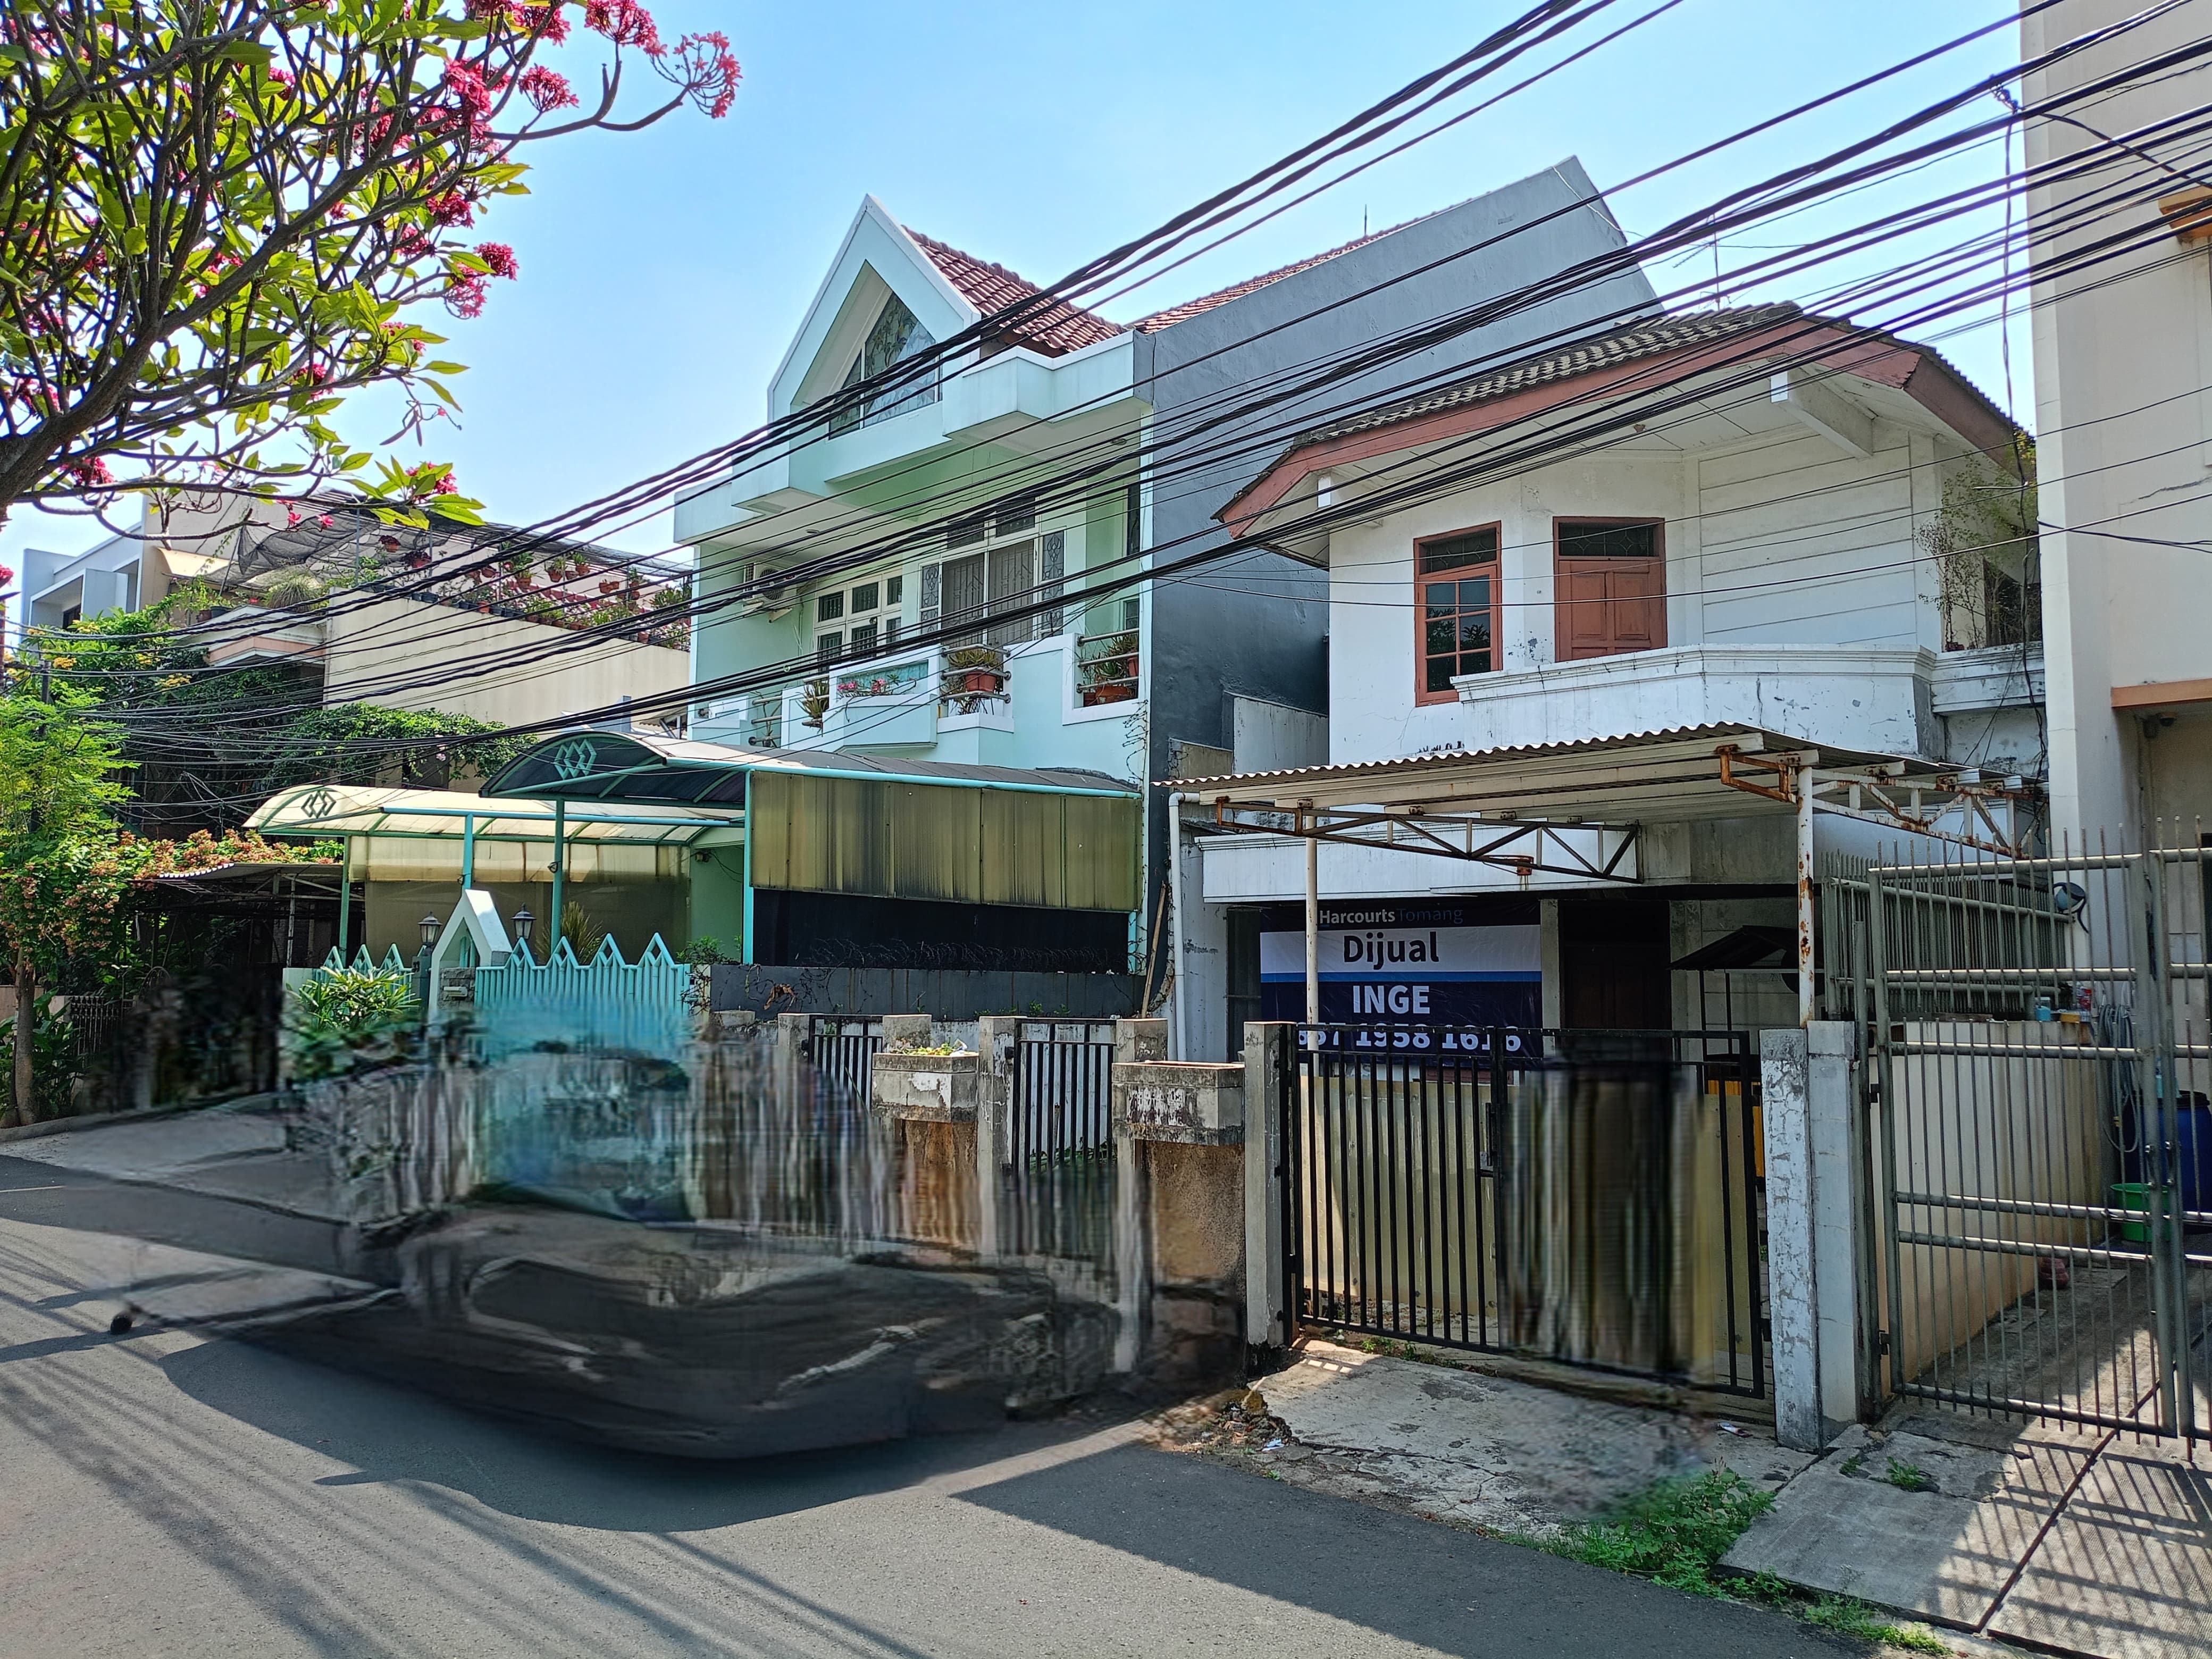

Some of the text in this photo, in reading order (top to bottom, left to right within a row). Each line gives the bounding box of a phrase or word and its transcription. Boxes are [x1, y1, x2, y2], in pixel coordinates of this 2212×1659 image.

[1320, 908, 1463, 924] Harcourts Tomang
[1343, 931, 1439, 970] Dijual
[1353, 985, 1430, 1014] INGE
[1356, 1023, 1430, 1049] 1958
